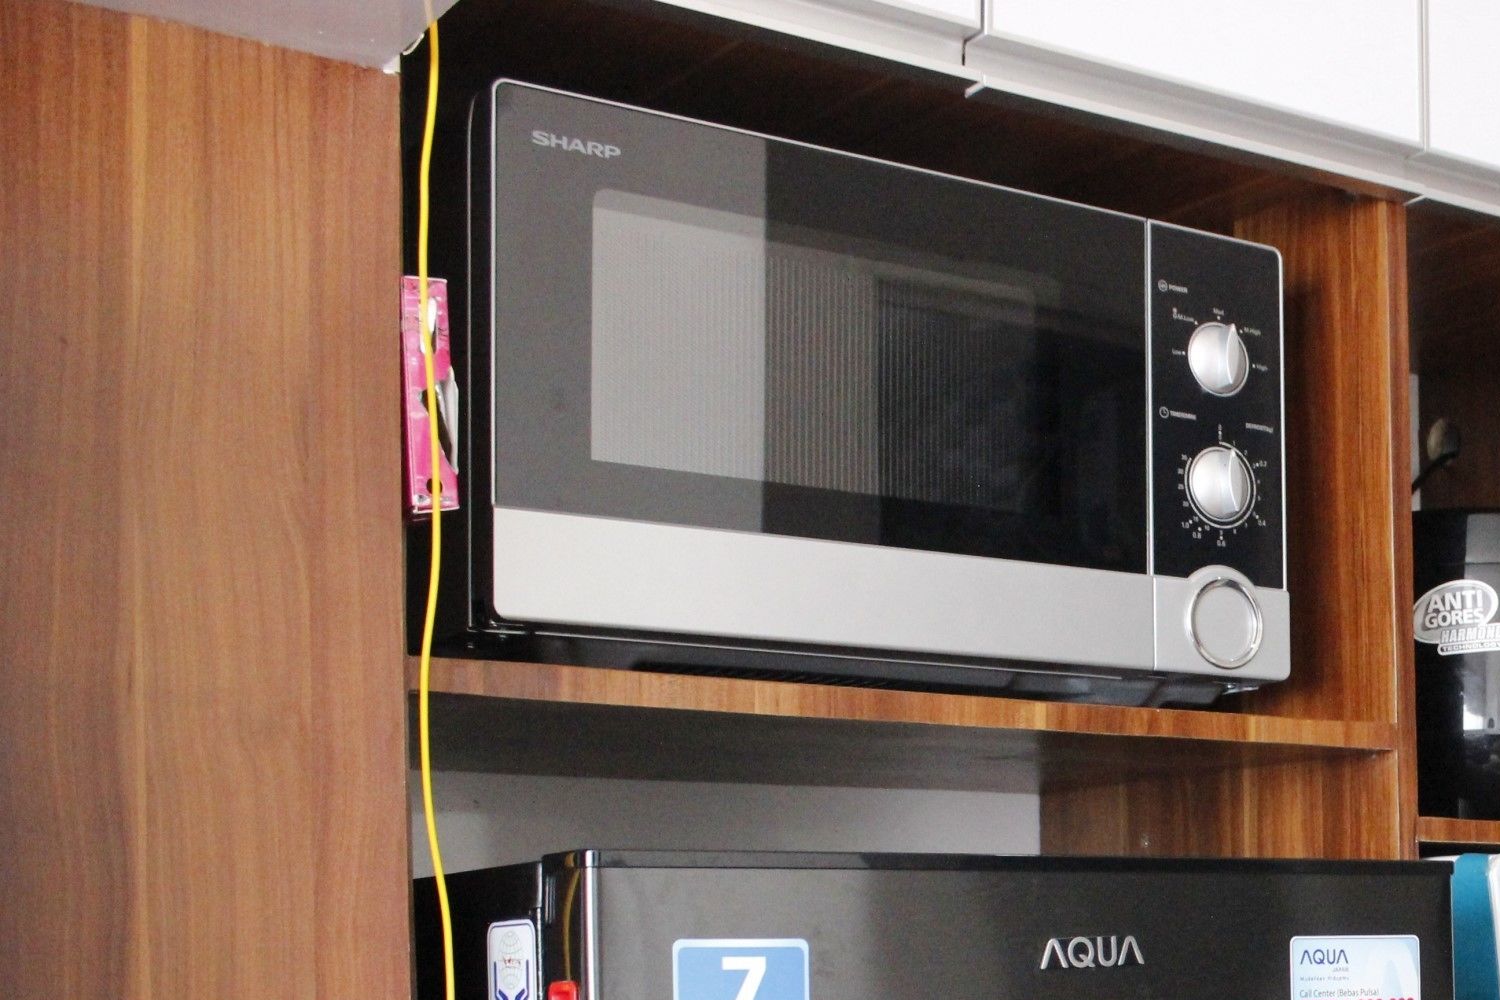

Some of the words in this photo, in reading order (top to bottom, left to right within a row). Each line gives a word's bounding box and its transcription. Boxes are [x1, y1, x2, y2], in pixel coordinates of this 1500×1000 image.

[531, 129, 622, 159] SHARP
[1427, 589, 1483, 613] ANTI
[1424, 607, 1485, 629] GORES
[1040, 935, 1145, 970] AQUA
[1300, 948, 1349, 965] AQUA
[1299, 989, 1311, 998] Call
[1313, 989, 1336, 998] Center
